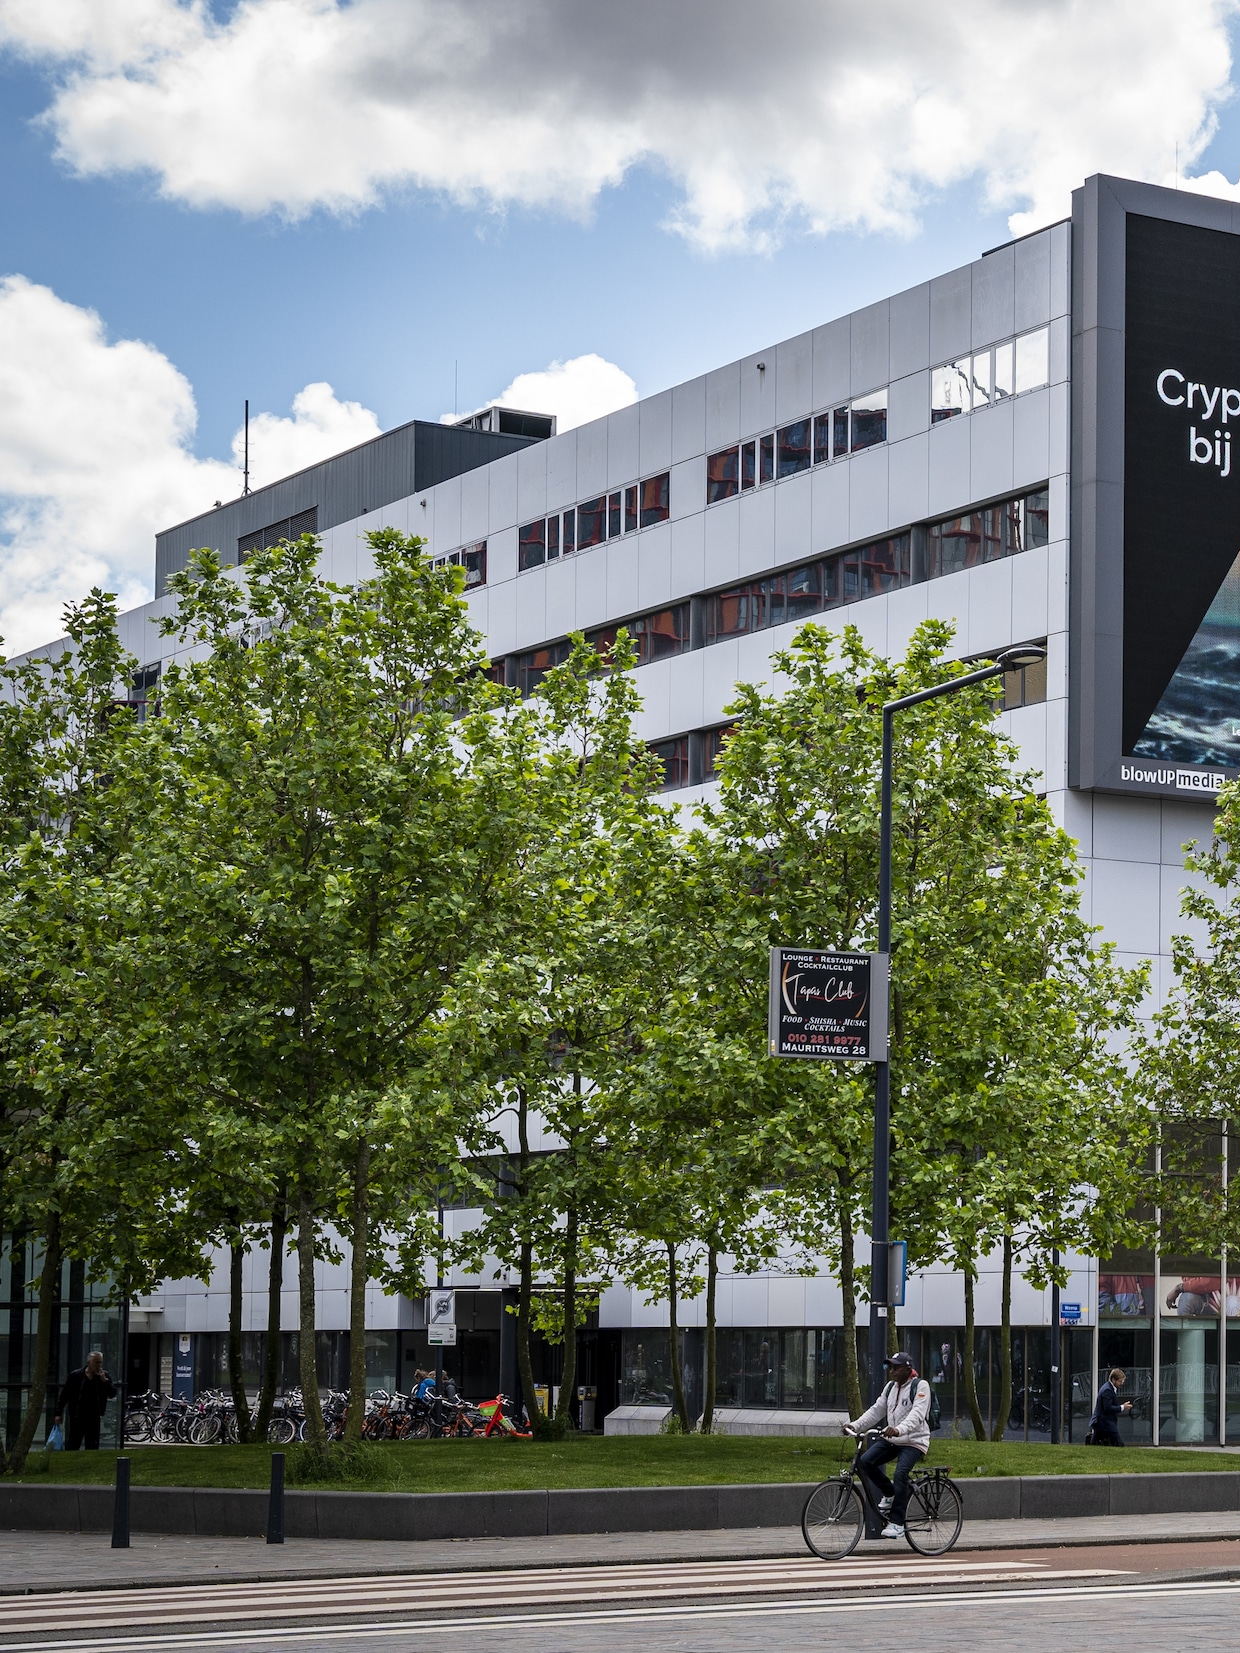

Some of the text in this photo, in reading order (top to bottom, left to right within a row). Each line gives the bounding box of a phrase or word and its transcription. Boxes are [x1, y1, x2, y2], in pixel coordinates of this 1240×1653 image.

[1190, 426, 1231, 477] bij
[782, 953, 869, 966] LOUNGE RESTAURANT
[797, 961, 854, 972] COCKTAILCLUB
[784, 973, 855, 1006] Tapas Club
[782, 1015, 867, 1027] FOOD SHISHA MUSIC
[804, 1023, 846, 1033] COCKTAILS
[787, 1033, 808, 1043] 010
[810, 1034, 830, 1045] 281
[782, 1042, 866, 1055] MAURITSWEG 28
